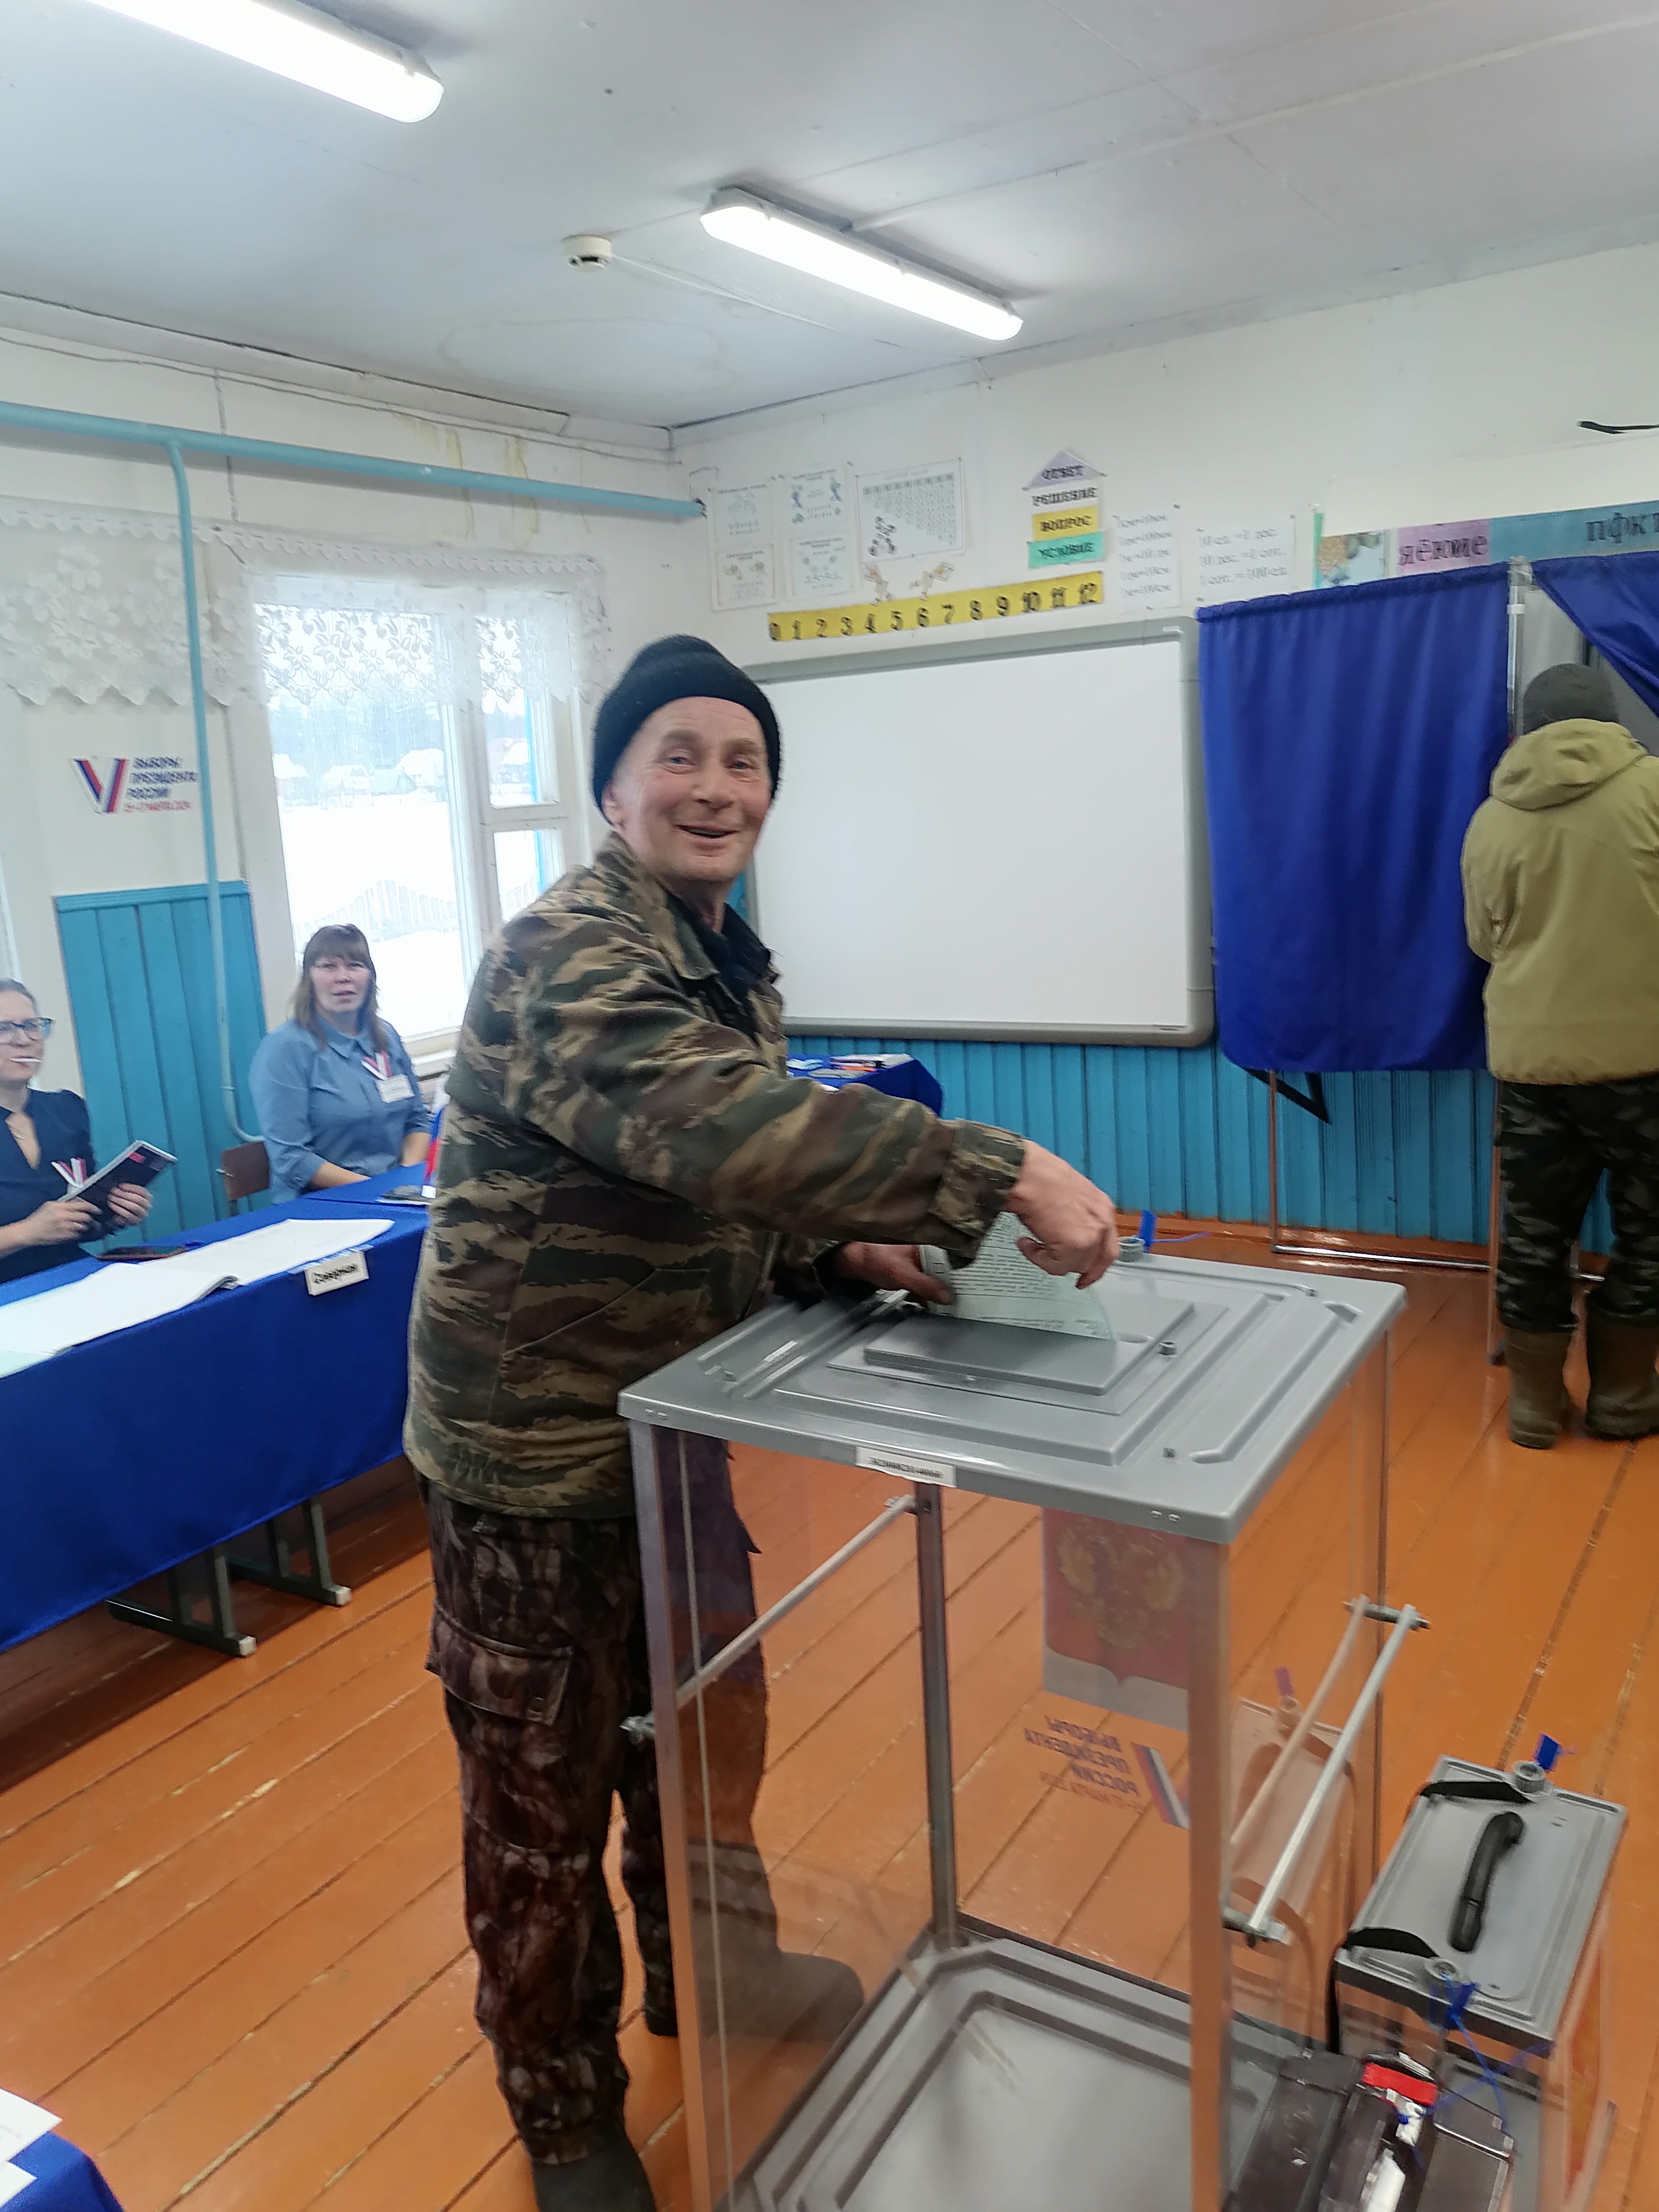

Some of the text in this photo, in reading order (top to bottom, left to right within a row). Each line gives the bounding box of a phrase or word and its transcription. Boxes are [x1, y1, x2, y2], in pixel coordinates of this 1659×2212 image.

[1031, 487, 1098, 507] РЕШЕНИЕ
[1039, 515, 1092, 532] ВОПРОС
[769, 622, 781, 641] 0
[792, 619, 801, 640] 1
[816, 618, 828, 638] 2
[840, 615, 853, 636] 3
[865, 613, 878, 633] 4
[890, 610, 902, 630] 5
[916, 607, 929, 627] 6
[941, 603, 955, 625] 7
[971, 599, 983, 620] 8
[997, 596, 1009, 617] 9
[1022, 591, 1041, 613] 10
[1051, 587, 1067, 608] 11
[1079, 582, 1098, 604] 12
